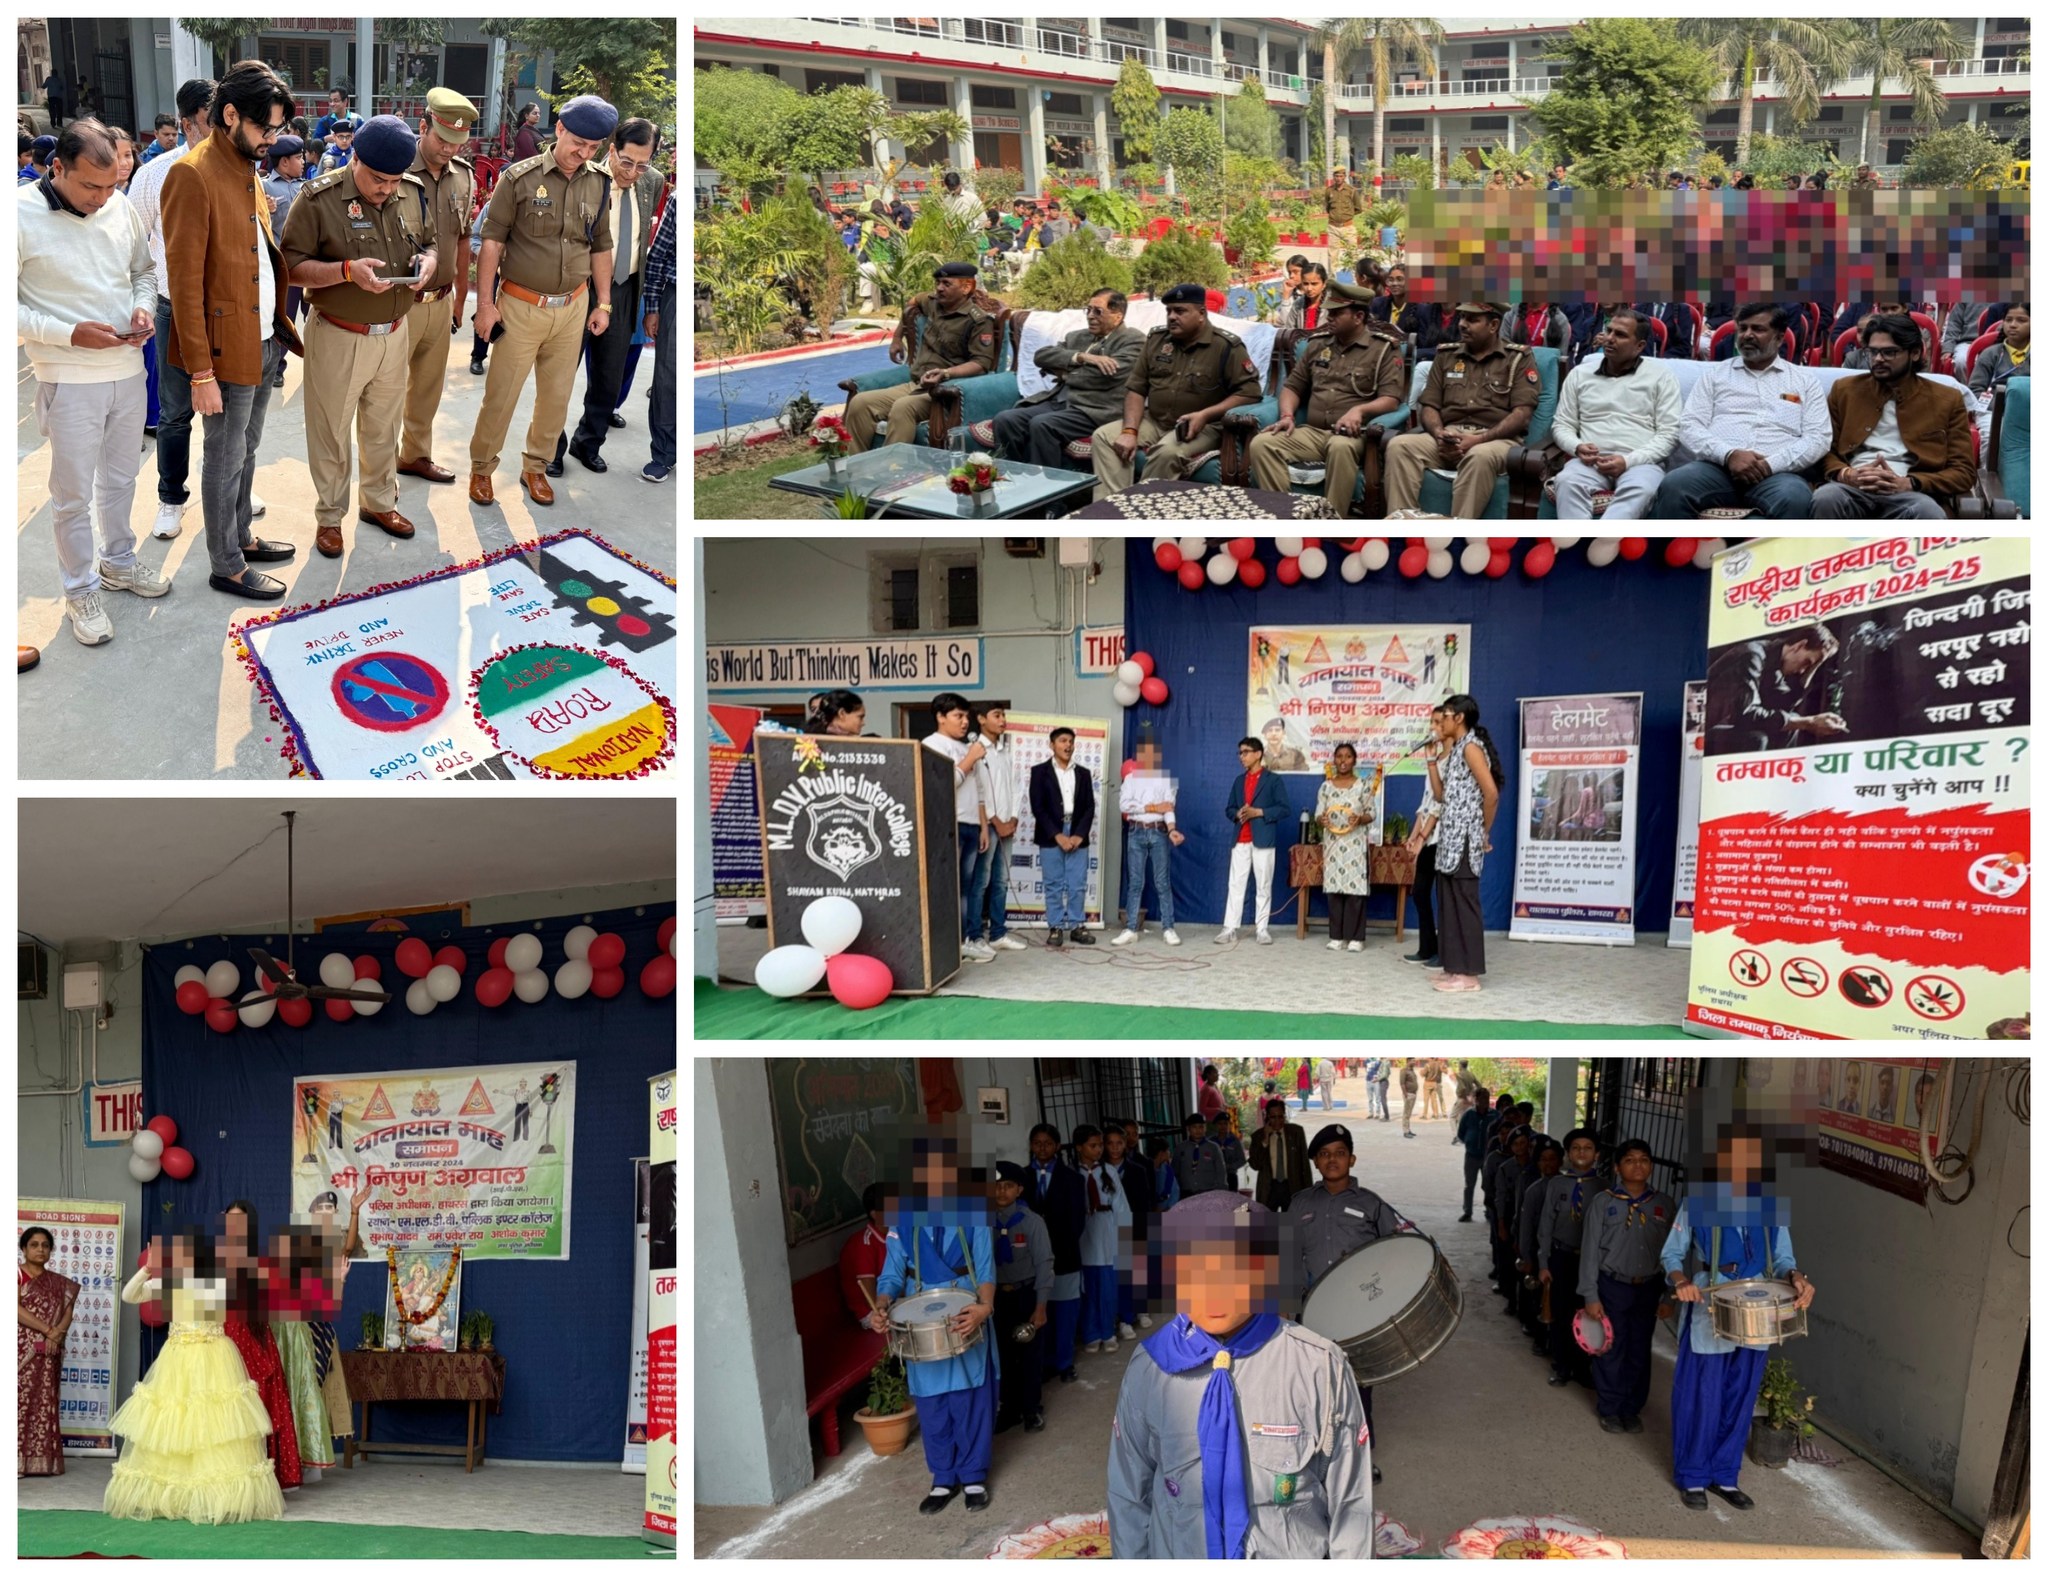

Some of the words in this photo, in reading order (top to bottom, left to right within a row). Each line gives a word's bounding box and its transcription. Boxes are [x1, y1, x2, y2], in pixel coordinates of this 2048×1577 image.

[1828, 127, 1854, 135] POWER
[1811, 537, 1916, 582] तम्बाकू
[488, 579, 518, 595] LIFE
[497, 588, 524, 601] SAVE
[505, 600, 542, 616] DRIVE
[519, 607, 550, 622] SAFE
[1769, 583, 1867, 626] कार्यक्रम
[1903, 594, 1987, 631] जिन्दगी
[359, 618, 389, 633] AND
[304, 631, 350, 650] DRIVE
[361, 628, 404, 647] NEVER
[1919, 634, 1984, 660] भरपूर
[304, 642, 356, 666] DRINK
[722, 648, 763, 682] World
[768, 647, 794, 682] But
[794, 646, 861, 686] Thinking
[866, 643, 918, 679] Makes
[925, 642, 937, 678] It
[946, 644, 972, 677] So
[502, 656, 572, 693] SAFETY
[1935, 665, 1960, 689] से
[1964, 658, 2007, 685] रहो
[1279, 698, 1302, 717] श्री
[1307, 697, 1357, 722] निपुण
[1361, 702, 1434, 719] अग्रवाल
[1550, 702, 1610, 731] हेलमेट
[1924, 702, 1973, 723] सदा
[1978, 697, 2016, 723] दूर
[422, 738, 454, 758] AND
[568, 722, 654, 771] NATIONAL
[370, 752, 417, 778] CROSS
[436, 751, 473, 773] STOP
[1716, 756, 1807, 784] तम्बाकू
[1814, 752, 1853, 774] या
[1863, 739, 1989, 772] परिवार
[2005, 737, 2029, 763] ?
[1855, 783, 1884, 798] क्या
[1892, 778, 1936, 801] चुनेंगे
[1944, 778, 1984, 794] आप
[797, 768, 856, 801] Public
[856, 773, 895, 812] Inter
[885, 803, 914, 857] College
[787, 886, 824, 897] SHAYAM
[854, 886, 901, 897] HATHRAS
[1698, 1007, 1726, 1025] जिला
[353, 1120, 452, 1153] यातायात
[457, 1121, 507, 1152] माह
[389, 1161, 400, 1169] 30
[402, 1160, 440, 1168] नवम्बर
[442, 1159, 464, 1167] 2024
[331, 1165, 359, 1188] श्री
[365, 1165, 429, 1197] निपुण
[433, 1166, 529, 1188] अग्रवाल
[35, 1212, 59, 1220] ROAD
[61, 1213, 87, 1222] SIGNS
[368, 1201, 393, 1215] पुलिस
[490, 1196, 514, 1207] किया
[521, 1212, 553, 1224] कॉलेज
[427, 1231, 442, 1241] राम
[490, 1229, 518, 1239] अशोक
[521, 1229, 546, 1242] कुमार
